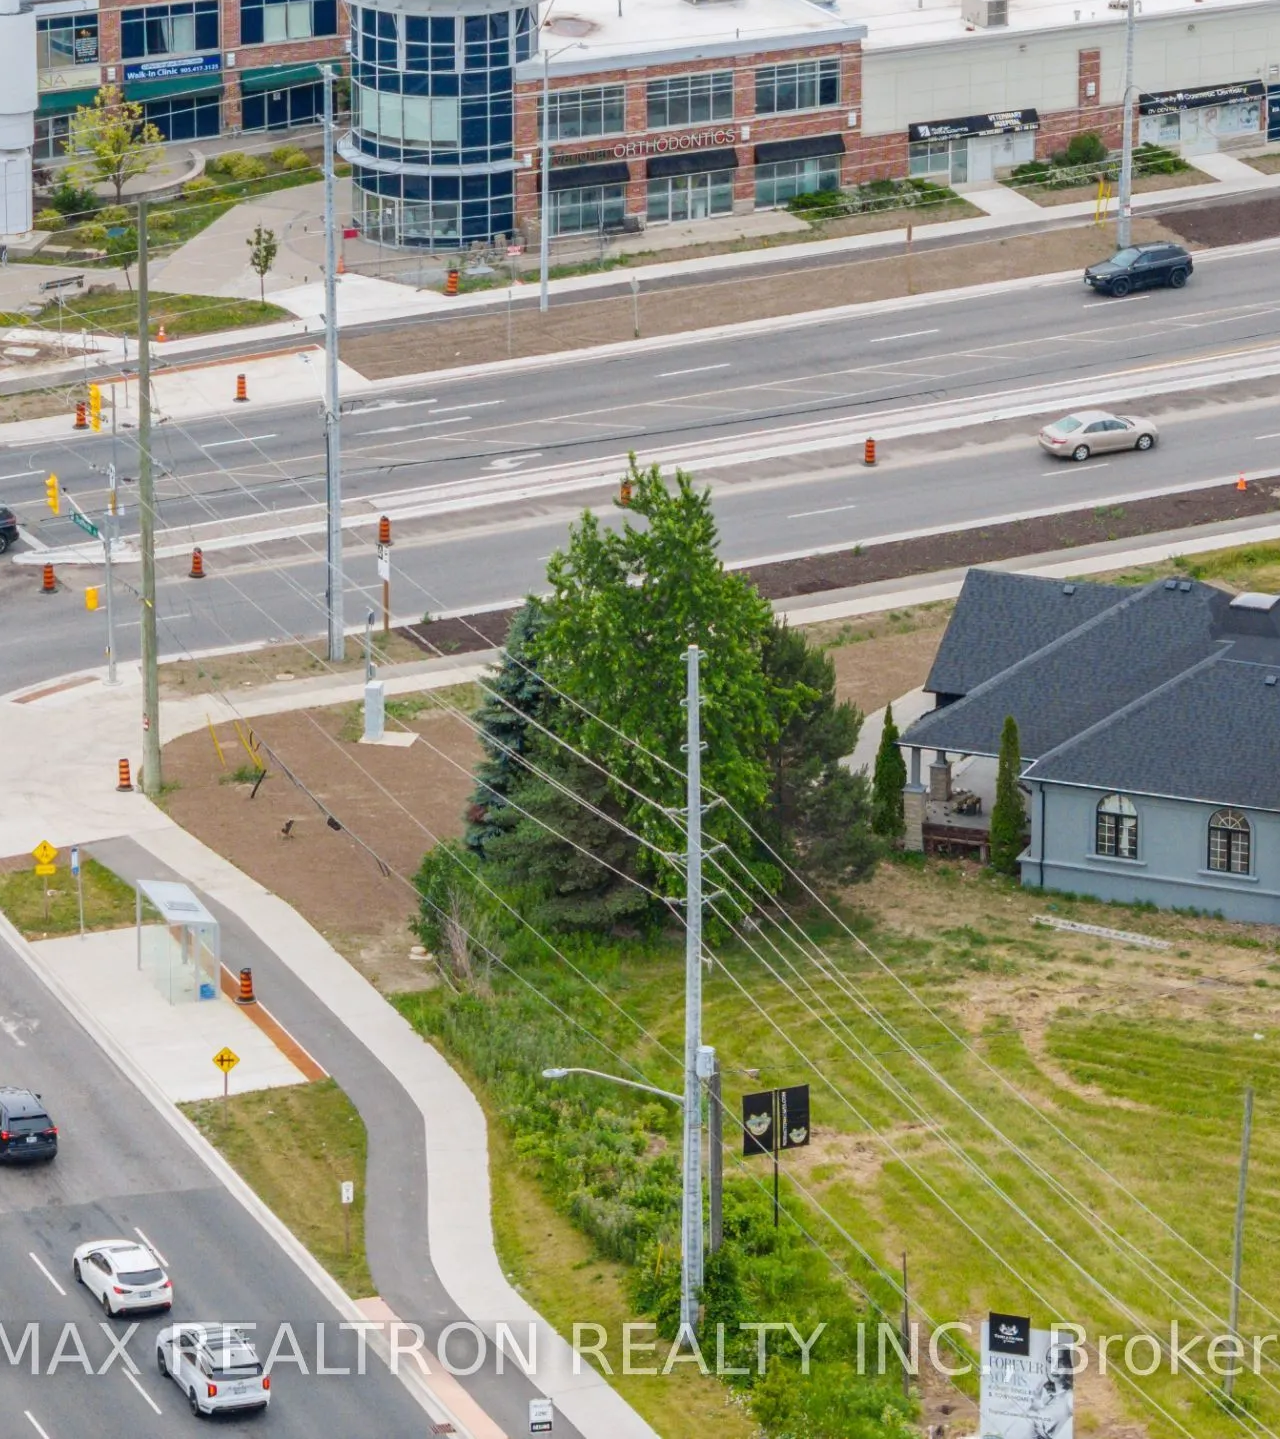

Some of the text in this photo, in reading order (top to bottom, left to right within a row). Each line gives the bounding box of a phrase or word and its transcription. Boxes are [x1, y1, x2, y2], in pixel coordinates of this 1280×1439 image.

[127, 70, 156, 80] Walk-In
[157, 67, 178, 76] Clinic
[613, 129, 736, 158] ORTHODONTICS
[989, 1355, 1044, 1375] FOREVER
